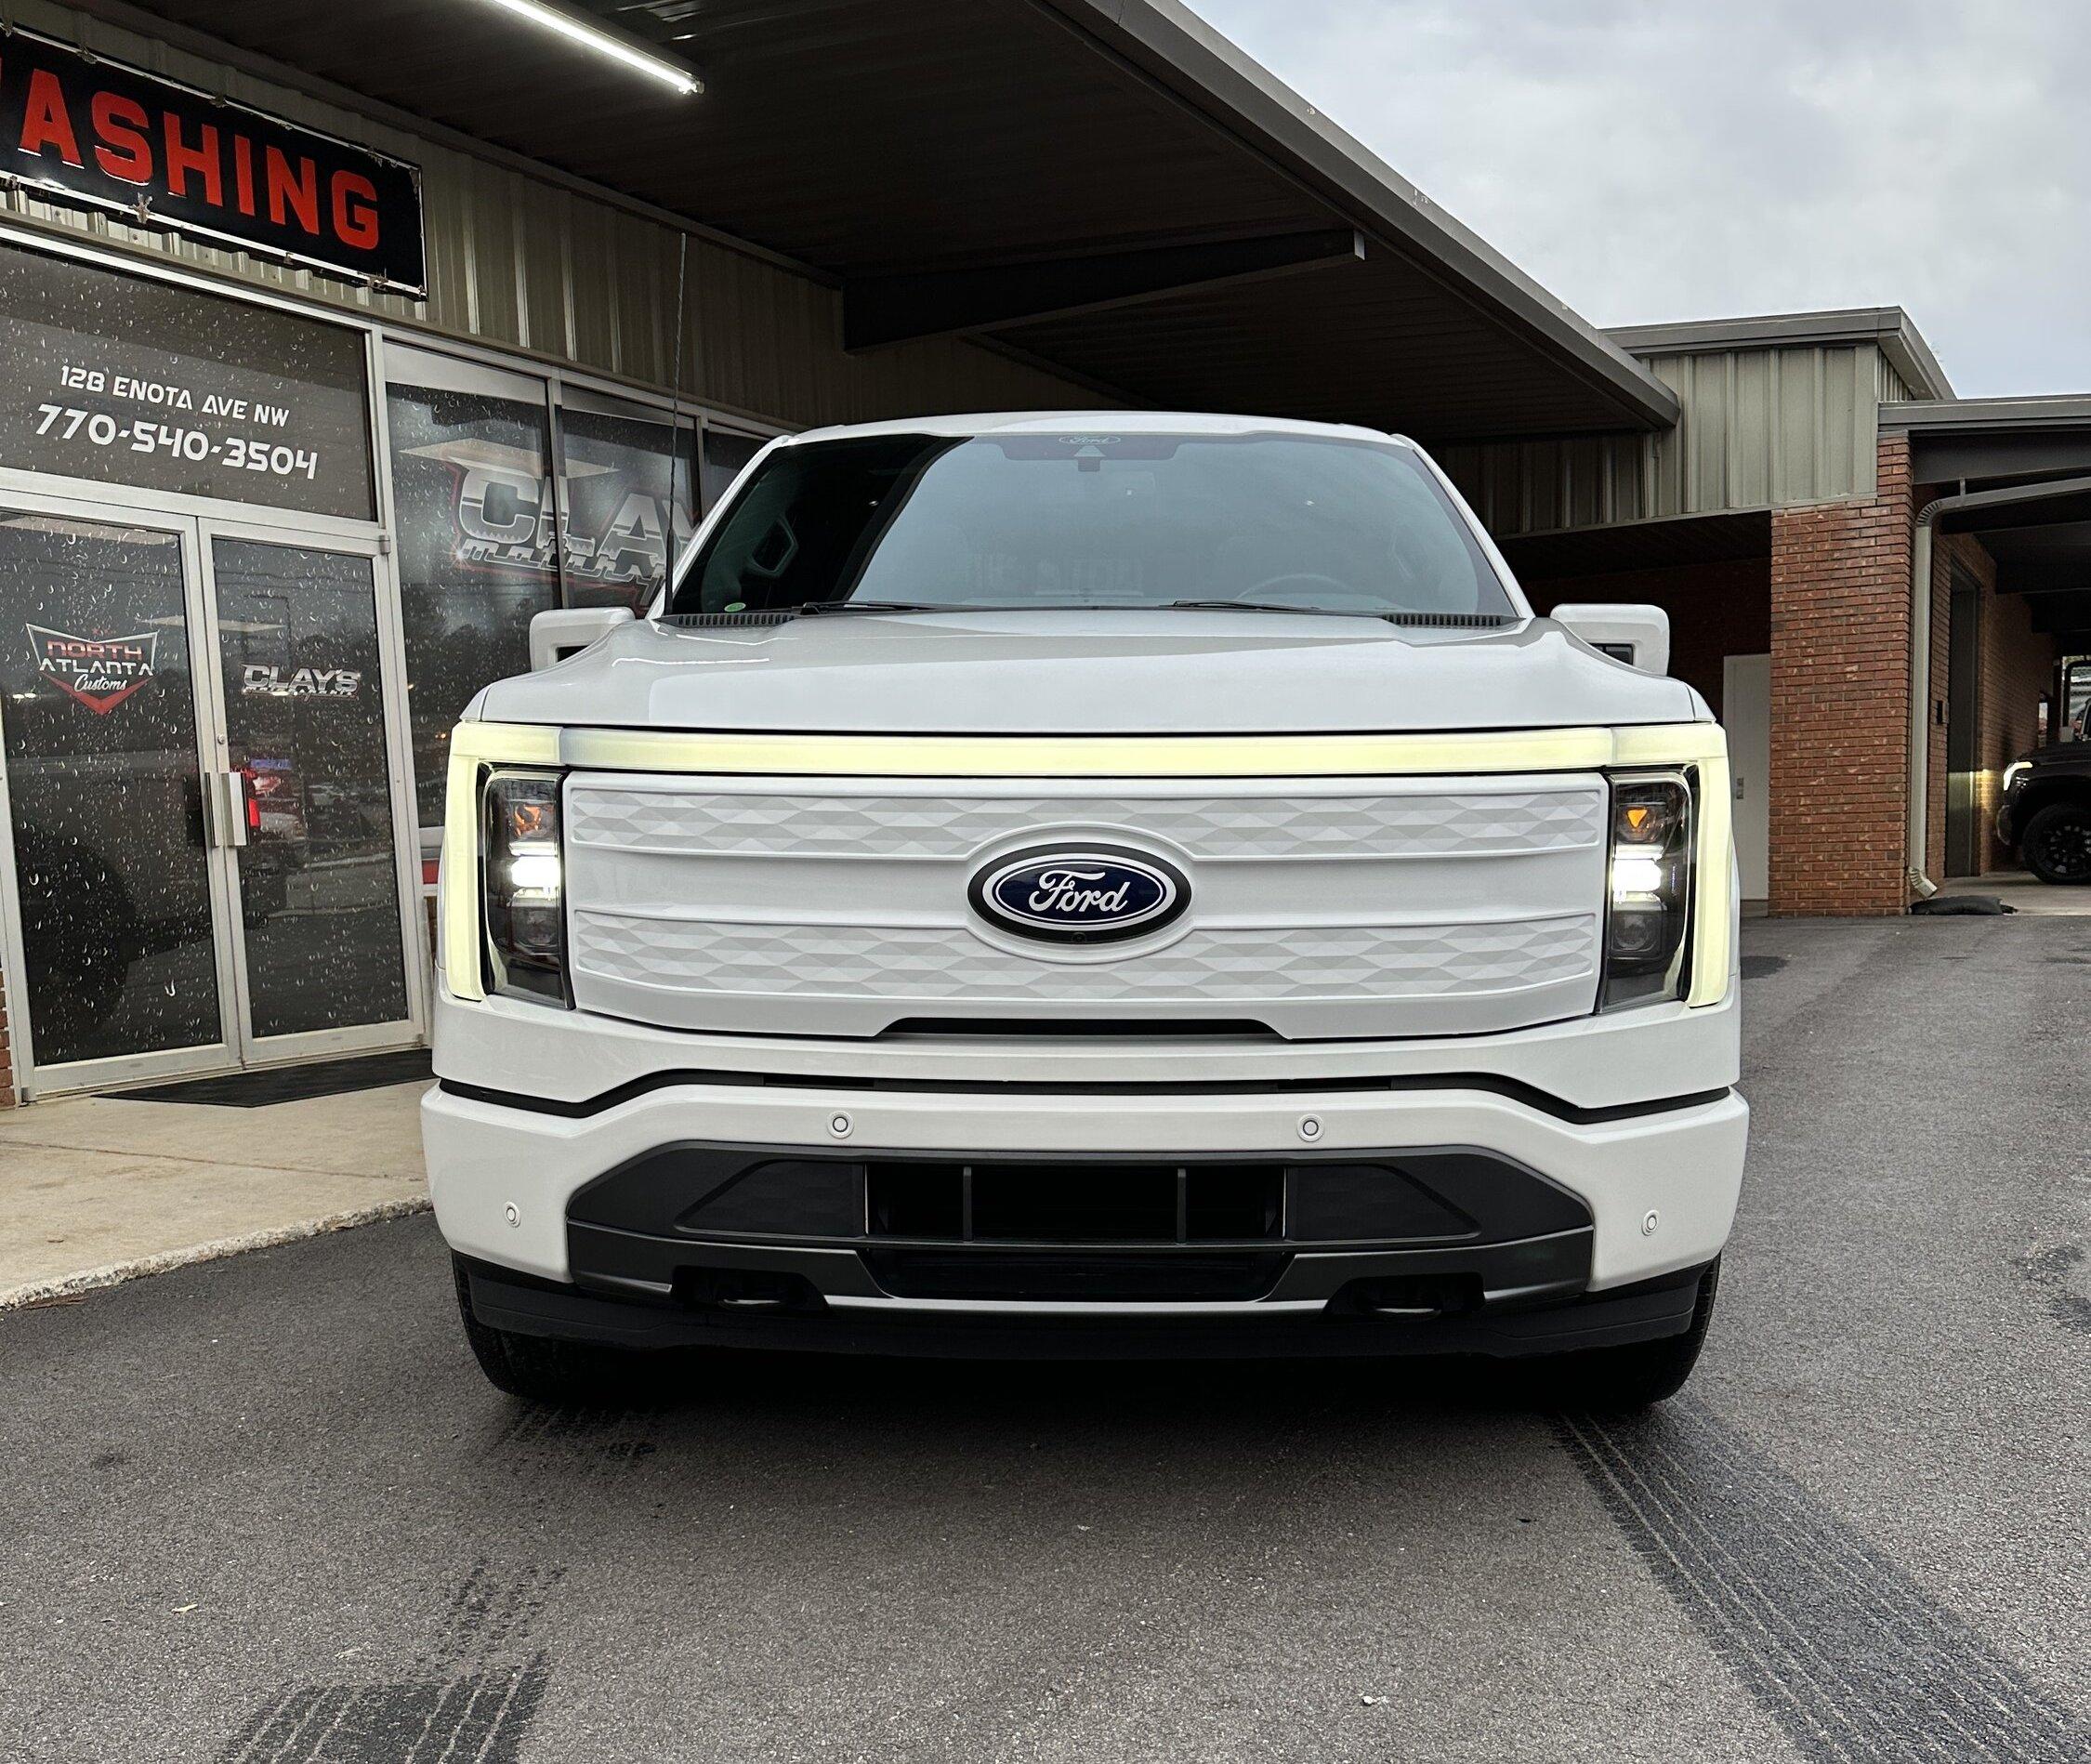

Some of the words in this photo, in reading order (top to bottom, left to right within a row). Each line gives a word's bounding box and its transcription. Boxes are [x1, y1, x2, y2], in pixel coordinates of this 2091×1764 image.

[0, 54, 379, 251] ASHING
[60, 365, 106, 393] 128
[112, 375, 193, 411] ENOTA
[202, 394, 248, 420] AVE
[254, 403, 290, 428] NW
[35, 403, 318, 480] 770-540-3504
[39, 657, 154, 677] ATLANTA
[46, 640, 143, 661] NORTH
[74, 674, 128, 692] Customs
[1028, 869, 1131, 913] Ford
